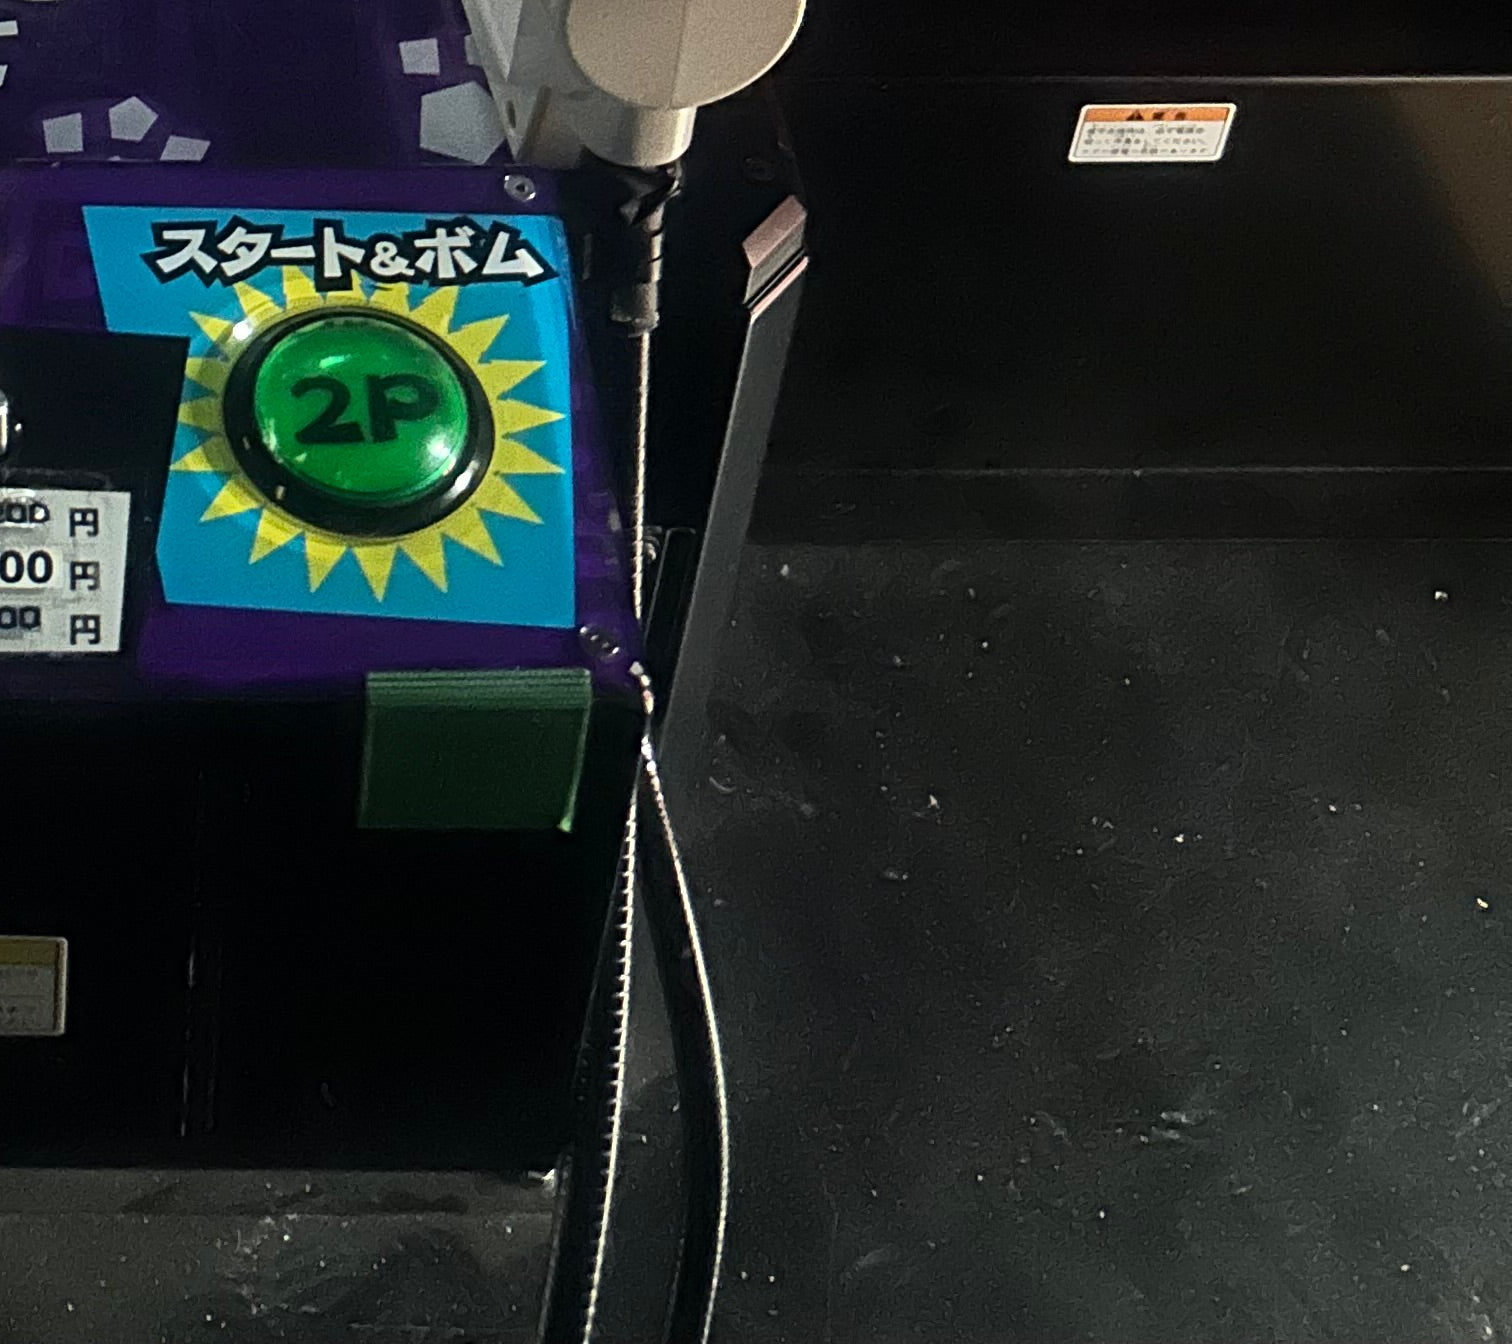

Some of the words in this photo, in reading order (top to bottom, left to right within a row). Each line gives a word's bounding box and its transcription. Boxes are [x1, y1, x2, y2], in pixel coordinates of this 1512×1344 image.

[151, 221, 550, 283] スタート&ボム
[289, 372, 441, 445] 2P
[69, 507, 100, 538] 円
[69, 560, 101, 592] 円
[69, 614, 102, 646] 円
